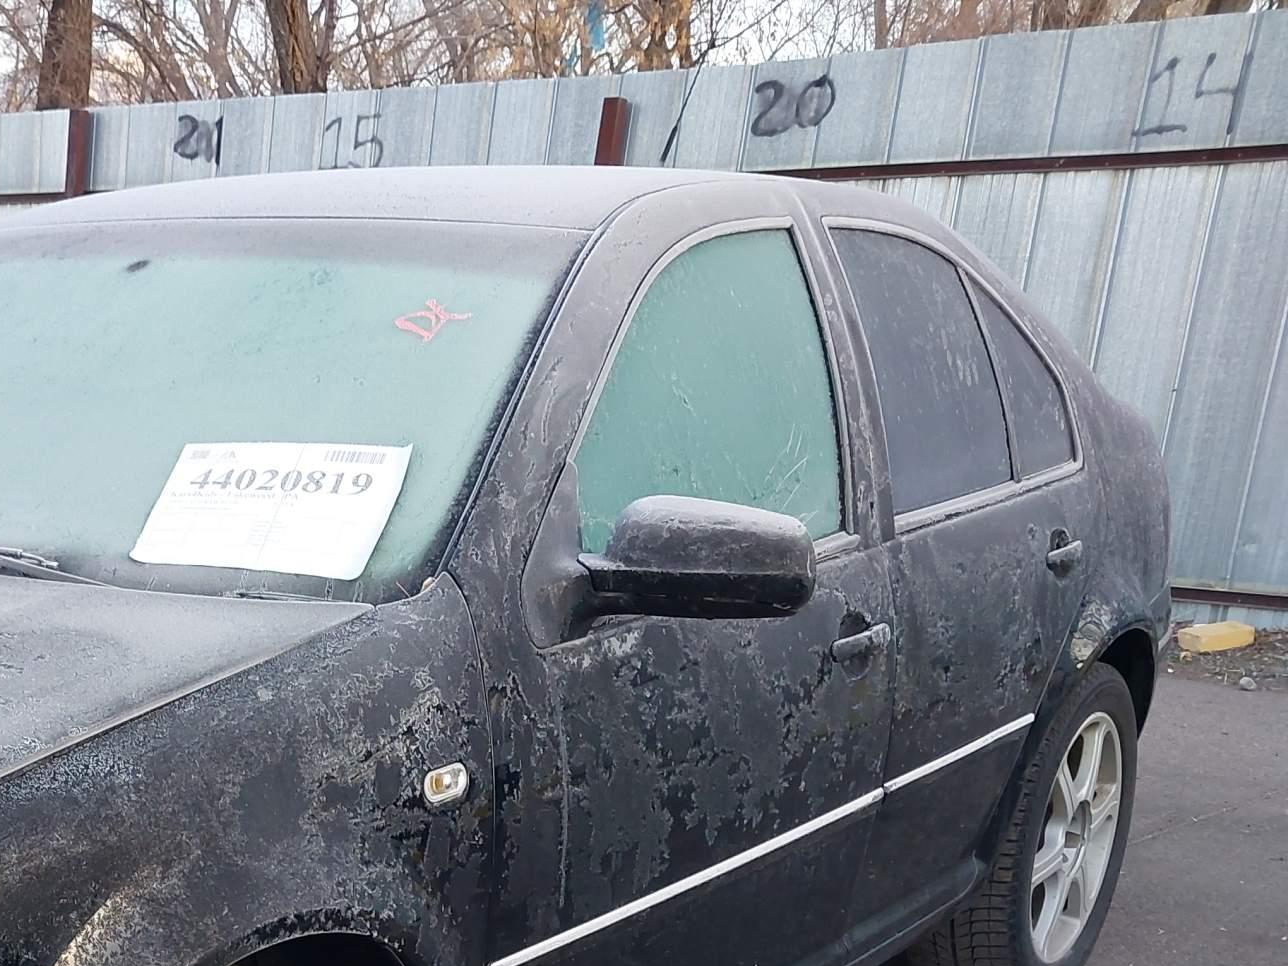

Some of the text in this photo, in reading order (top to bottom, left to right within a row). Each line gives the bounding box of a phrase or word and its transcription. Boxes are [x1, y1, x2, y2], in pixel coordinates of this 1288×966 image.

[751, 74, 836, 137] 20
[318, 113, 382, 170] 15
[189, 467, 374, 496] 44020819
